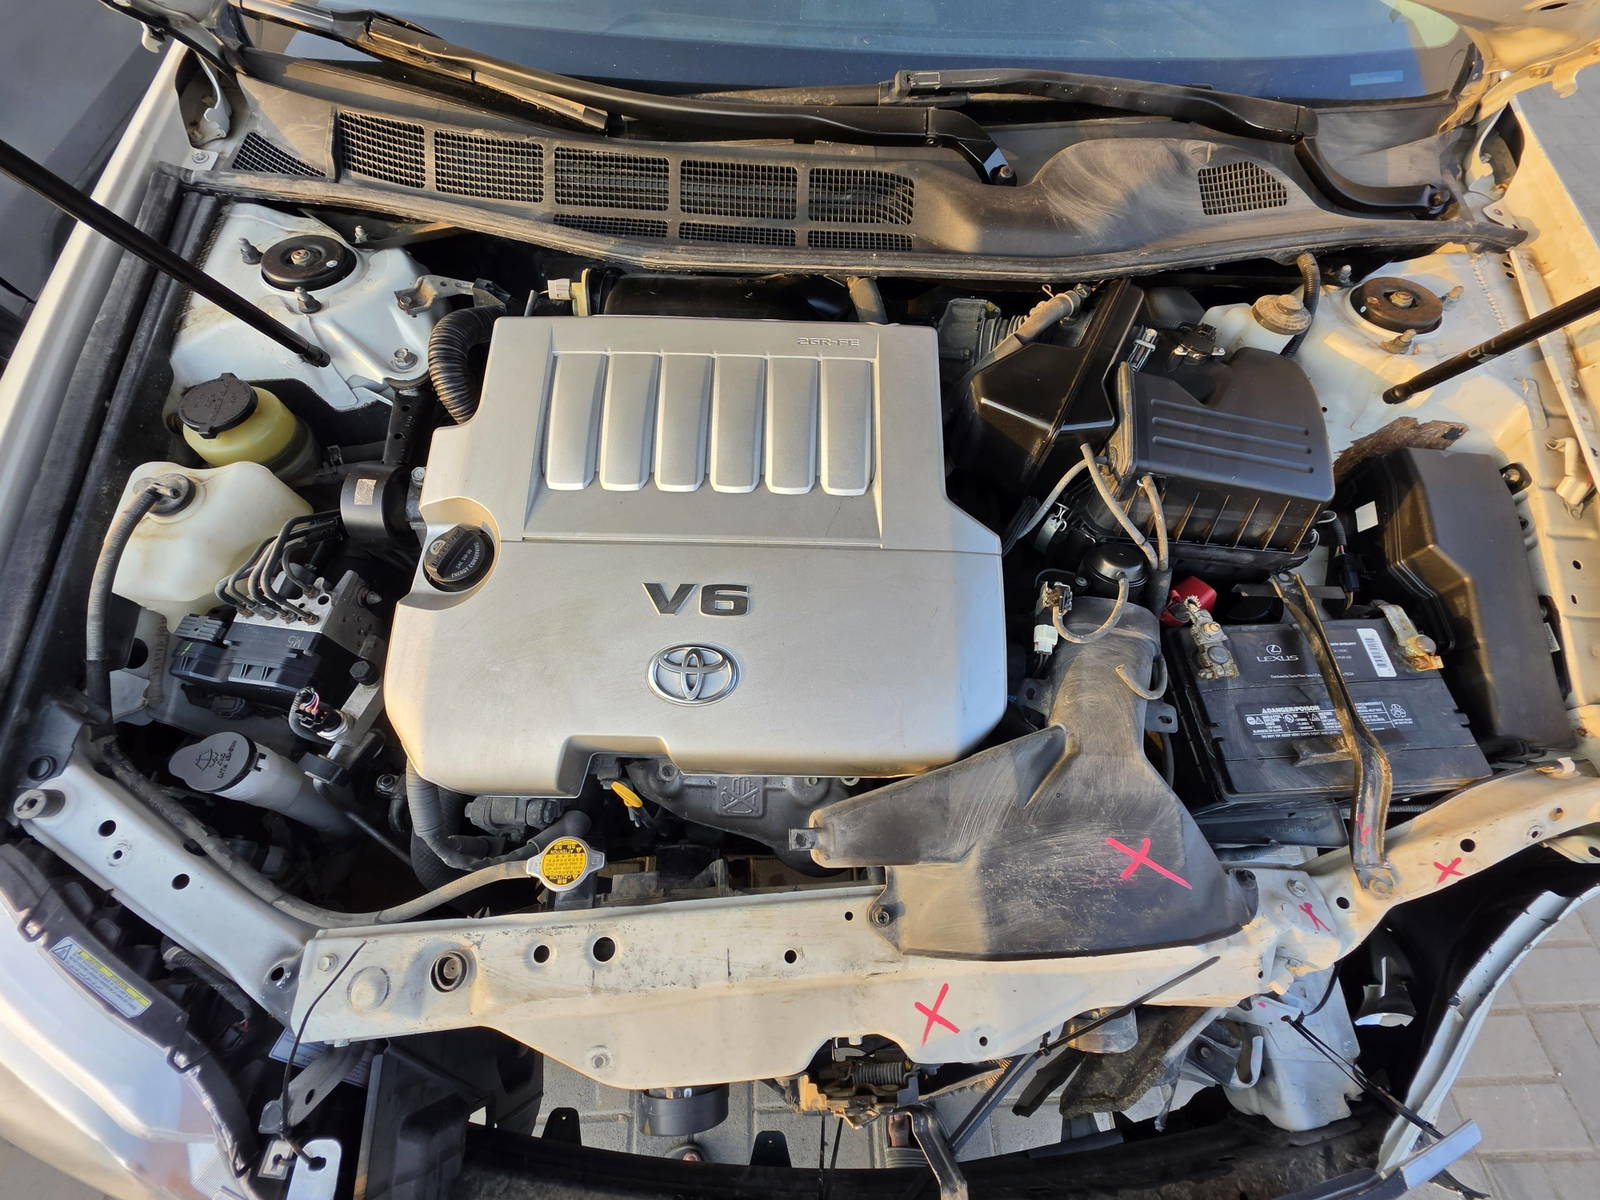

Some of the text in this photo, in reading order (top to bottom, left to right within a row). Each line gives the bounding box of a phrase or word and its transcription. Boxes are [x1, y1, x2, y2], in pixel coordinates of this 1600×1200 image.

[797, 337, 860, 346] 2GR-FE
[452, 568, 469, 578] ENERGY
[641, 582, 749, 617] V6
[1256, 654, 1299, 663] LEXUS
